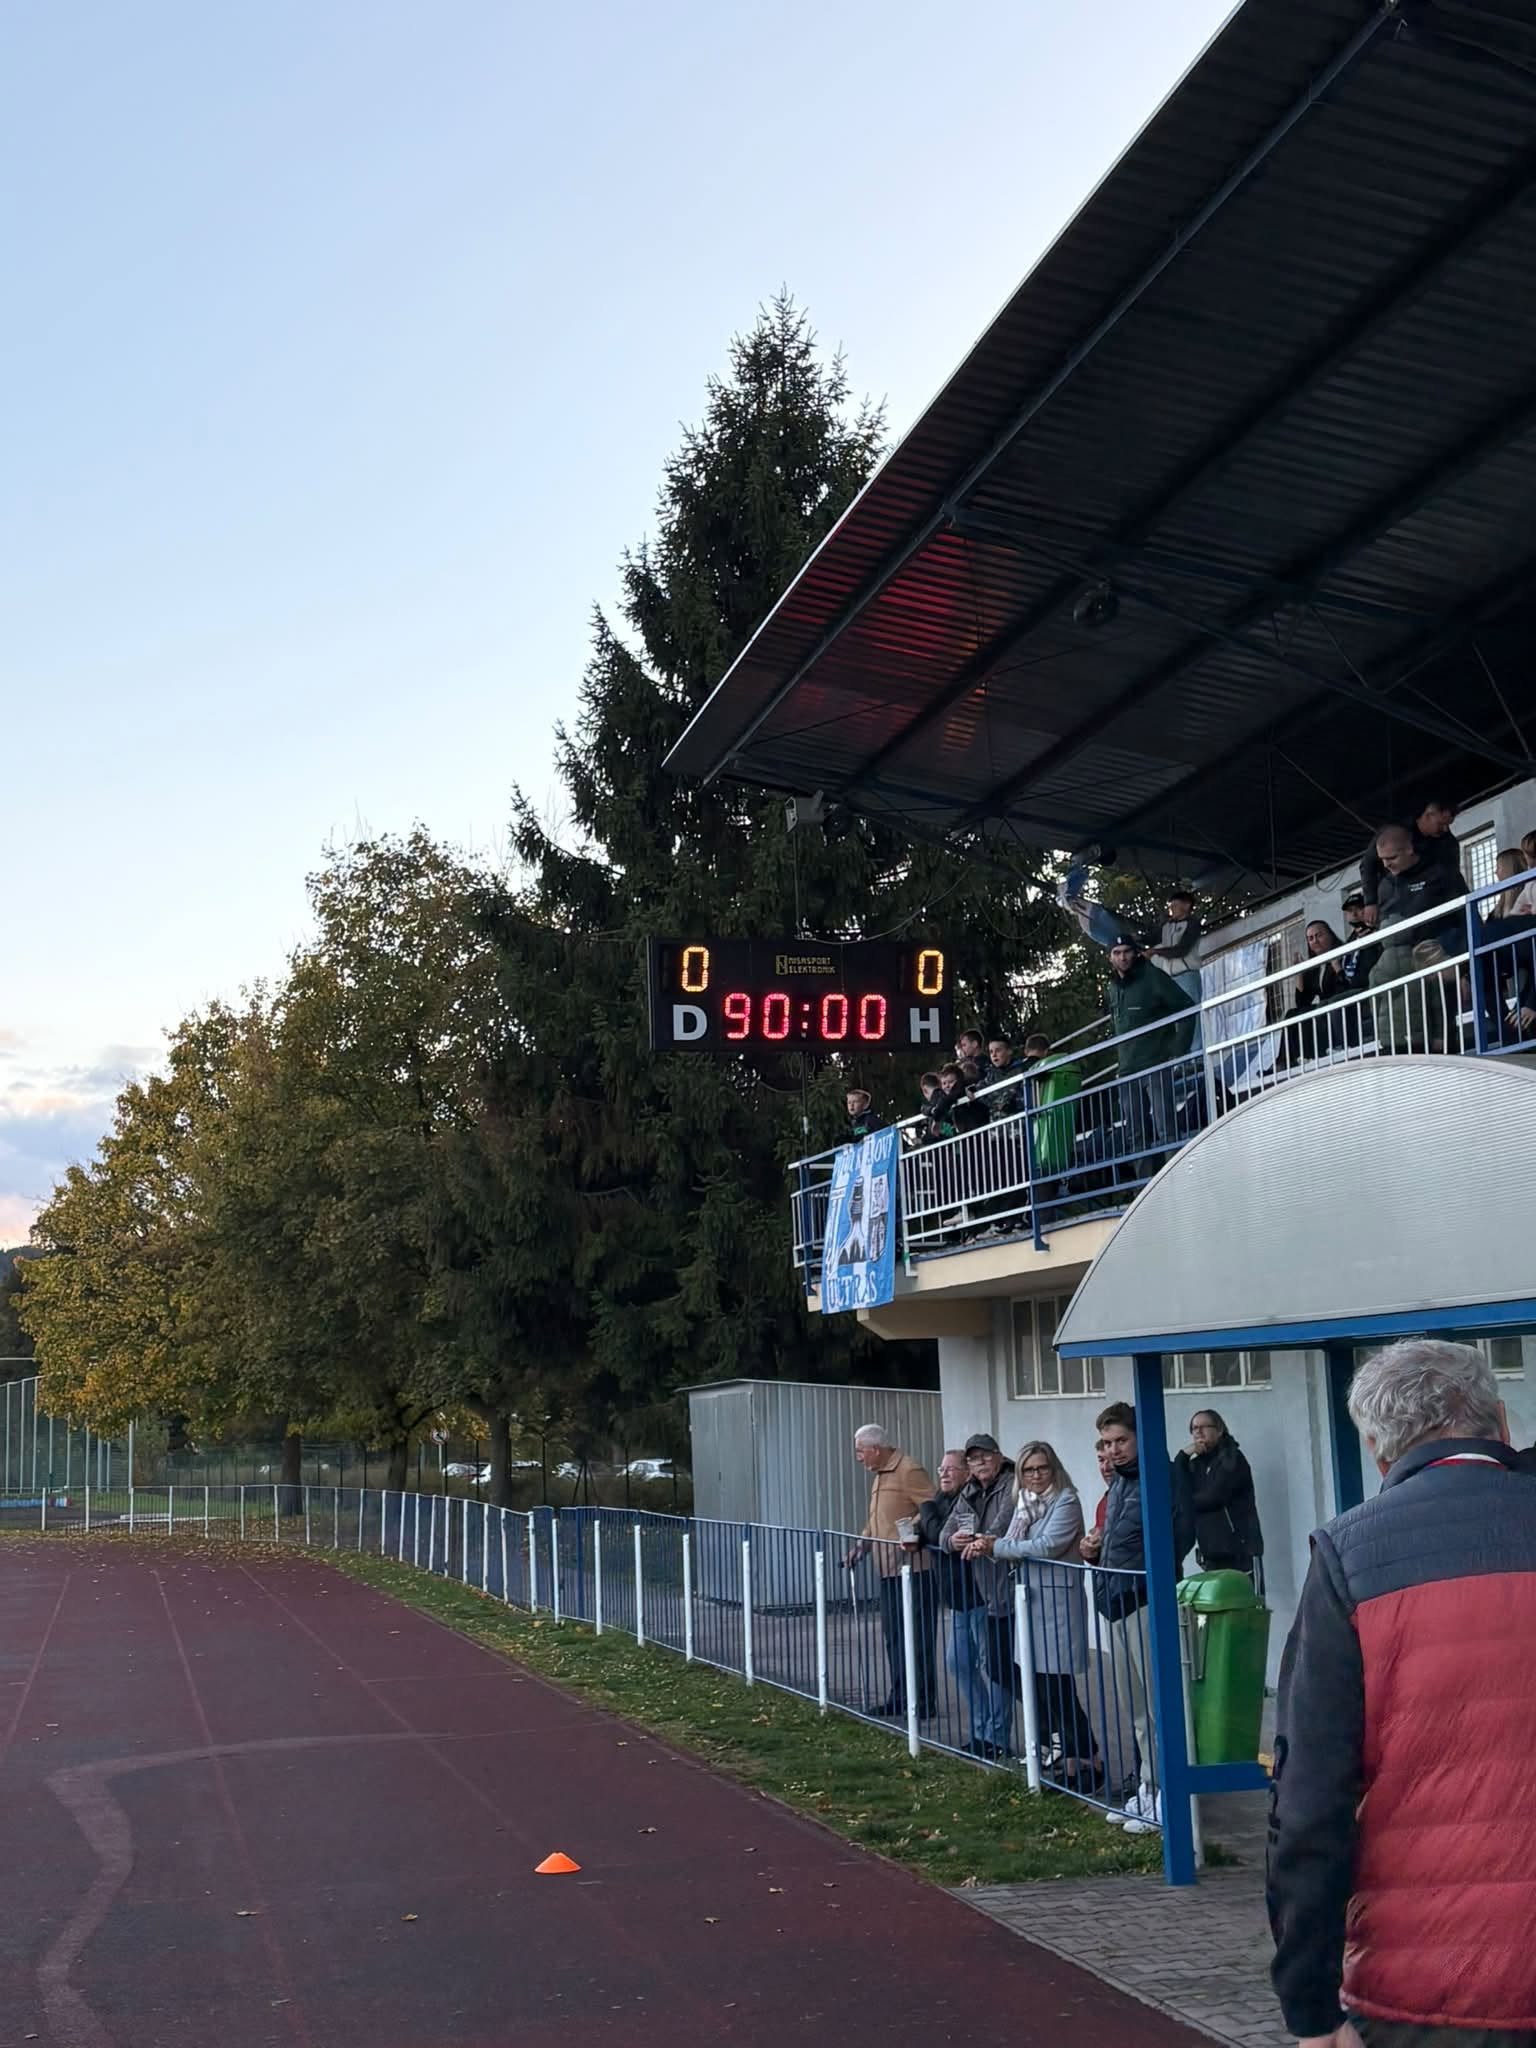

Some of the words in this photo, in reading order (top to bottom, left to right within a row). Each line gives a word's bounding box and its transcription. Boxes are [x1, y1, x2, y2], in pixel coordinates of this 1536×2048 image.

[682, 946, 709, 992] 0
[917, 949, 944, 995] 0
[672, 1003, 708, 1041] D
[724, 992, 887, 1040] 90:00
[909, 1007, 941, 1043] H
